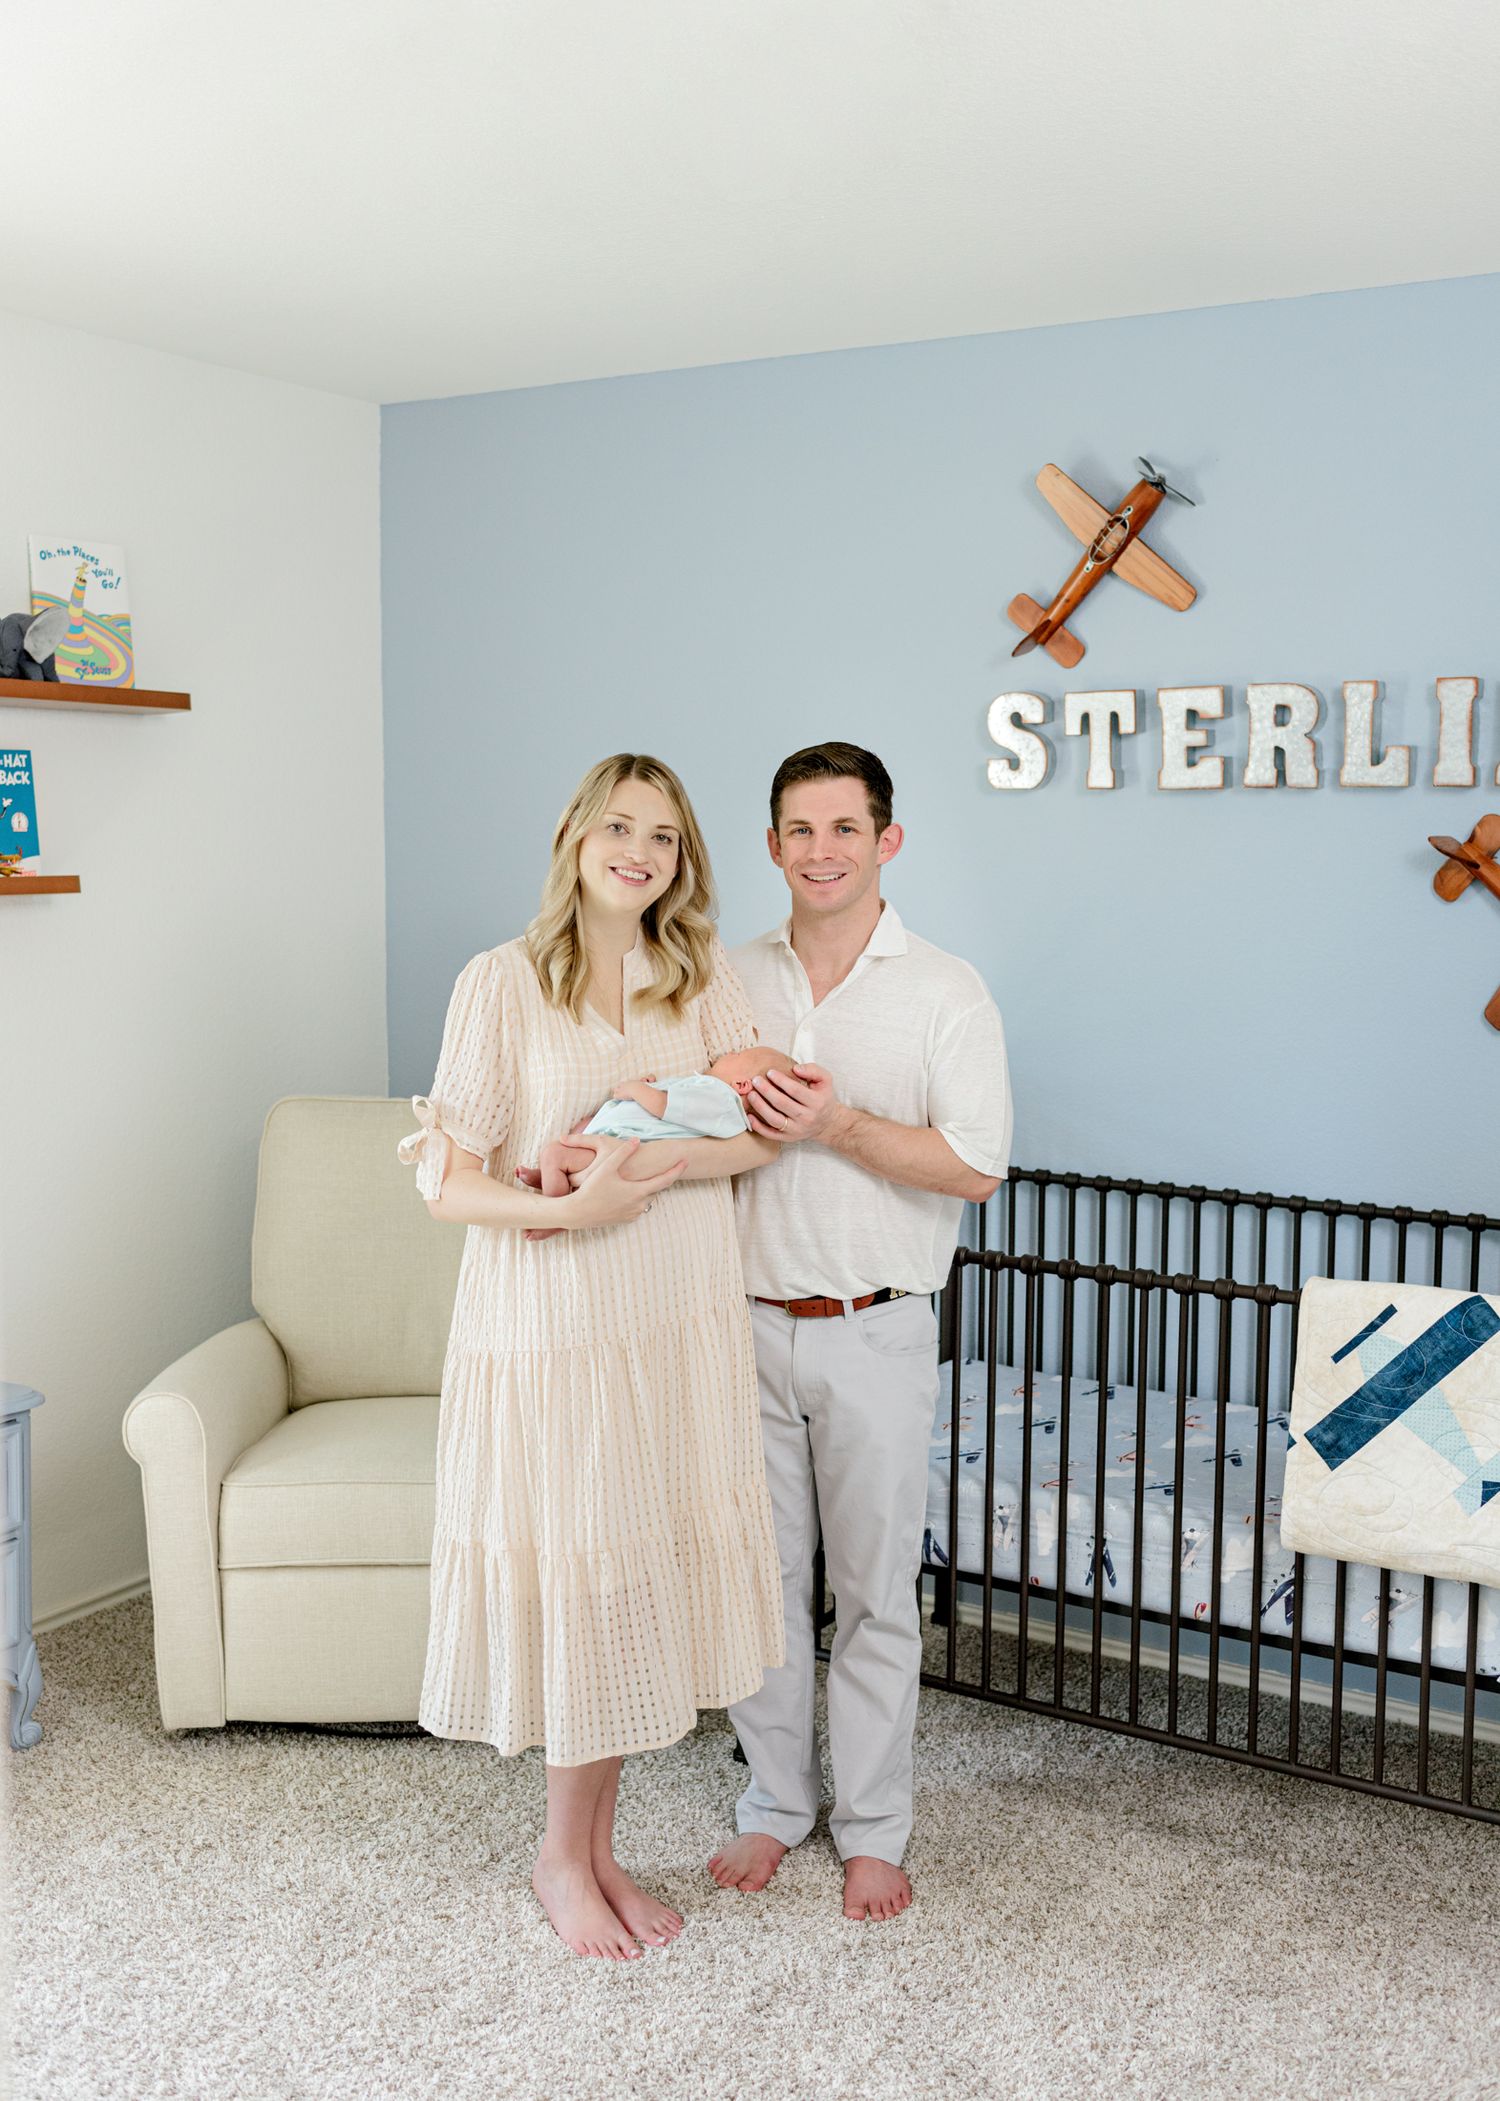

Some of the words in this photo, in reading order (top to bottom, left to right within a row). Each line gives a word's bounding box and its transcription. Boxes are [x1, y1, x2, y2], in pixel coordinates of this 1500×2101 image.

[57, 548, 71, 556] the
[73, 545, 100, 566] Places
[101, 577, 120, 589] Go!
[986, 676, 1500, 790] STERLI
[3, 753, 27, 768] HAT
[0, 769, 31, 786] BACK
